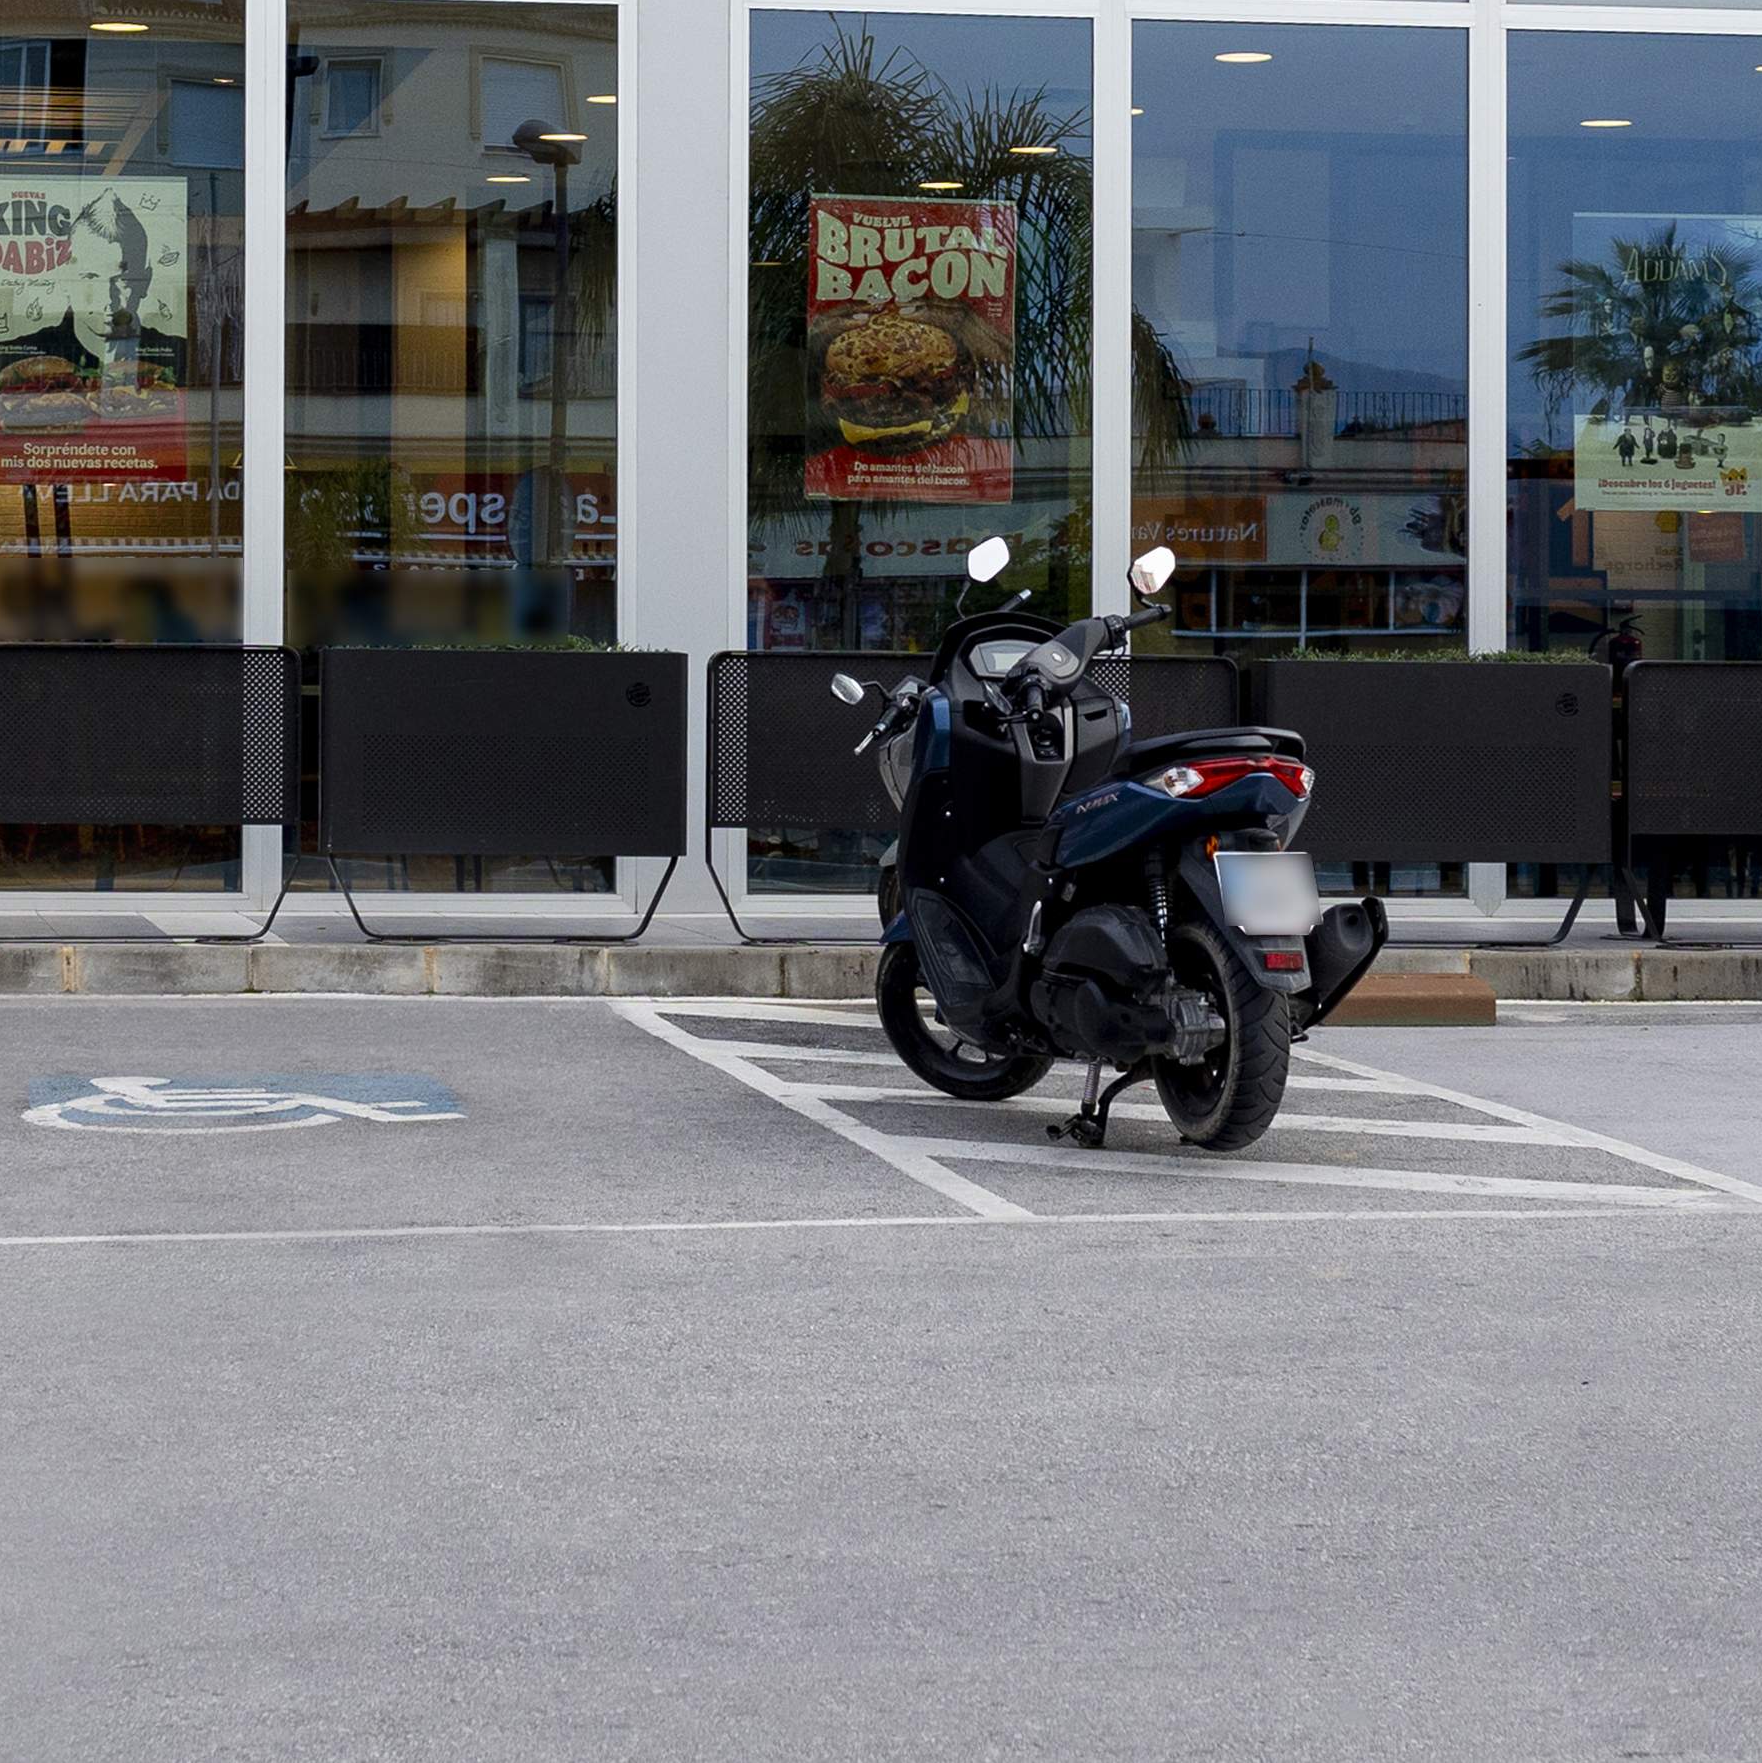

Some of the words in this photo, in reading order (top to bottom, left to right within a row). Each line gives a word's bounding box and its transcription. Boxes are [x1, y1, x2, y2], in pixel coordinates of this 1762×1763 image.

[11, 191, 46, 199] NUEVAS
[852, 212, 912, 227] VUELVE
[817, 209, 1008, 267] BRUTAL
[1622, 245, 1728, 287] ADDAMS
[816, 251, 1007, 302] BACON
[23, 442, 108, 457] Sorpréndete
[111, 445, 136, 456] con
[0, 456, 24, 468] mis
[26, 456, 51, 468] dos
[53, 458, 101, 469] nuevas
[104, 458, 159, 469] recetas.
[854, 461, 868, 471] De
[870, 463, 912, 473] amantes
[915, 463, 932, 473] del
[847, 474, 871, 485] para
[873, 474, 915, 484] amantes
[917, 475, 934, 485] del
[935, 475, 970, 486] bacon.
[1648, 478, 1663, 488] los
[1664, 479, 1671, 488] 6
